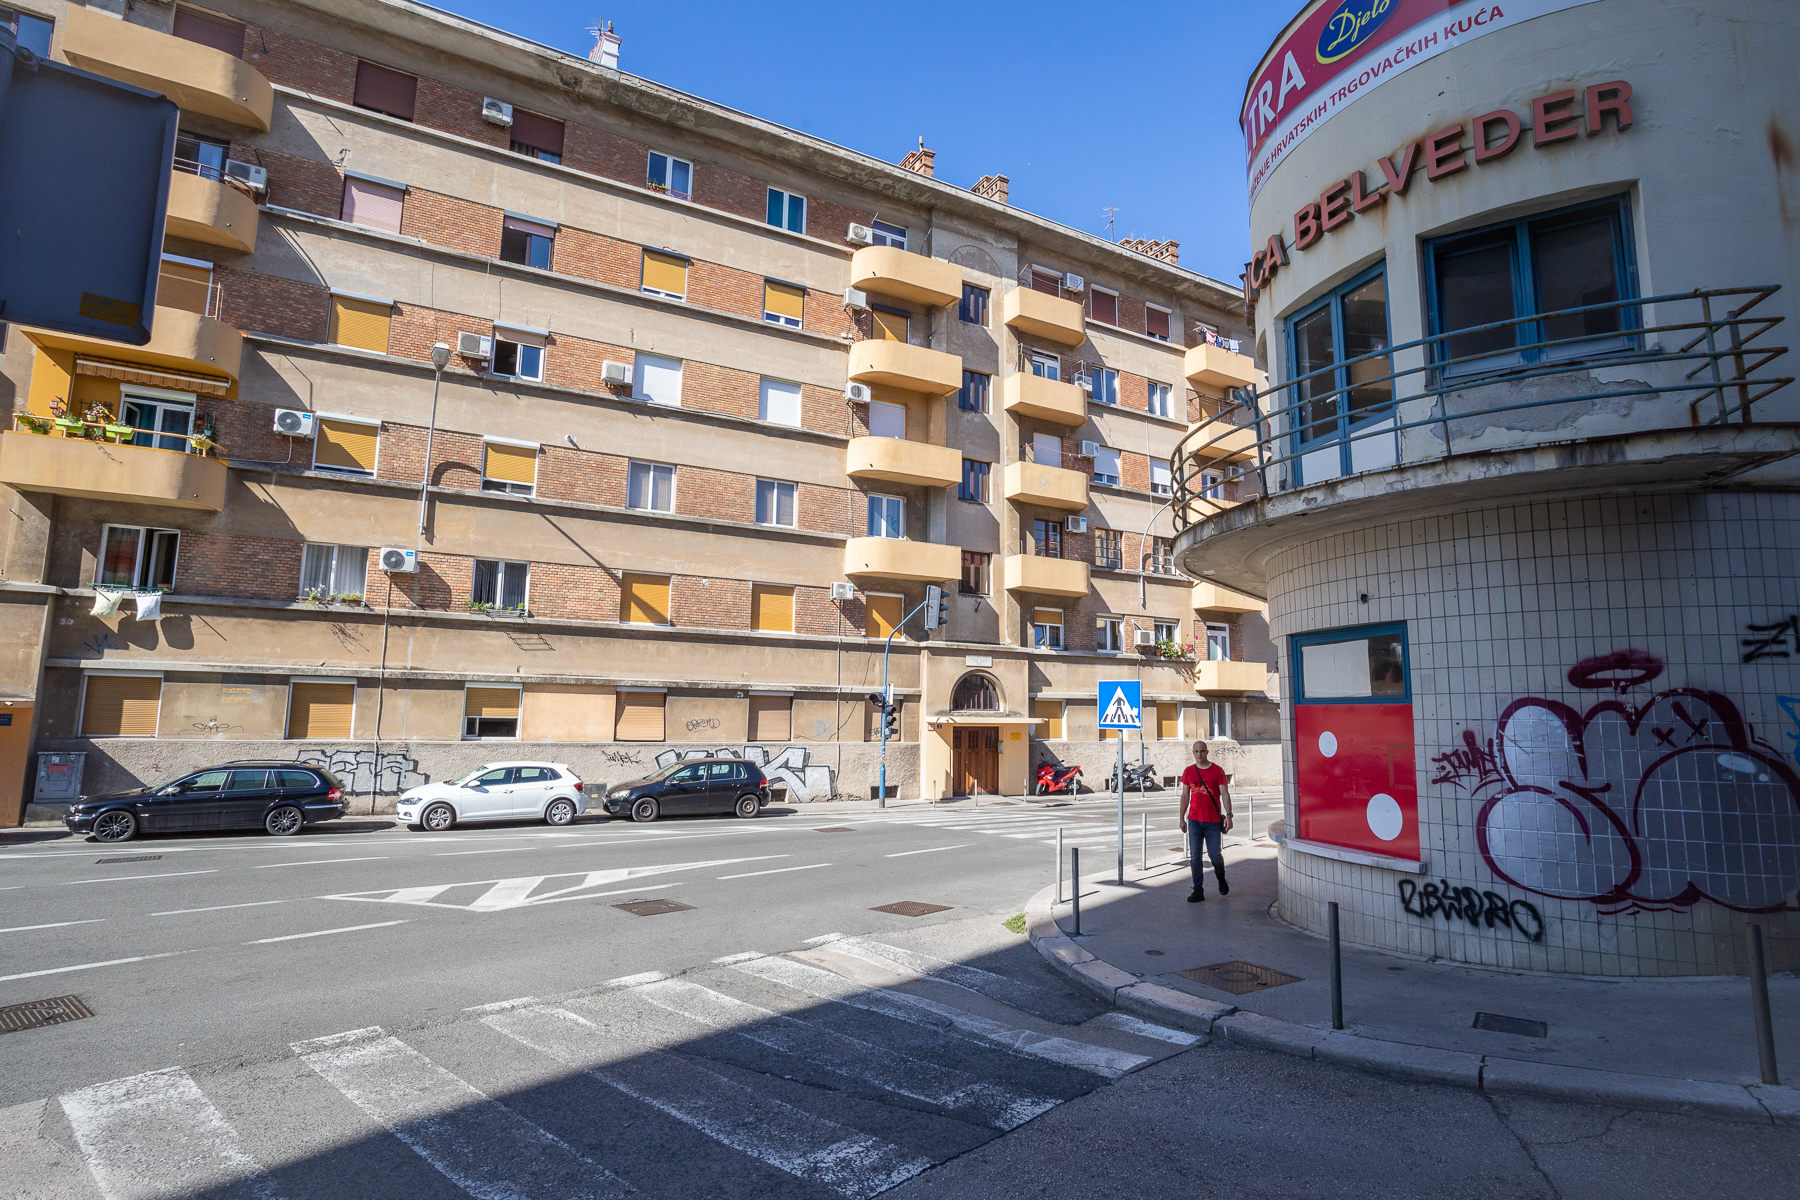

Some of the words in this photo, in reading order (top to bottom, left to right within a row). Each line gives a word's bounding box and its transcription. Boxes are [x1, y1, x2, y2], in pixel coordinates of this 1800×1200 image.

[1270, 100, 1328, 163] HRVATSKIH
[1329, 30, 1439, 107] TRGOVAČKIH
[1443, 5, 1504, 41] KUĆA
[1328, 0, 1390, 51] Djelo
[1293, 80, 1634, 252] BELVEDER
